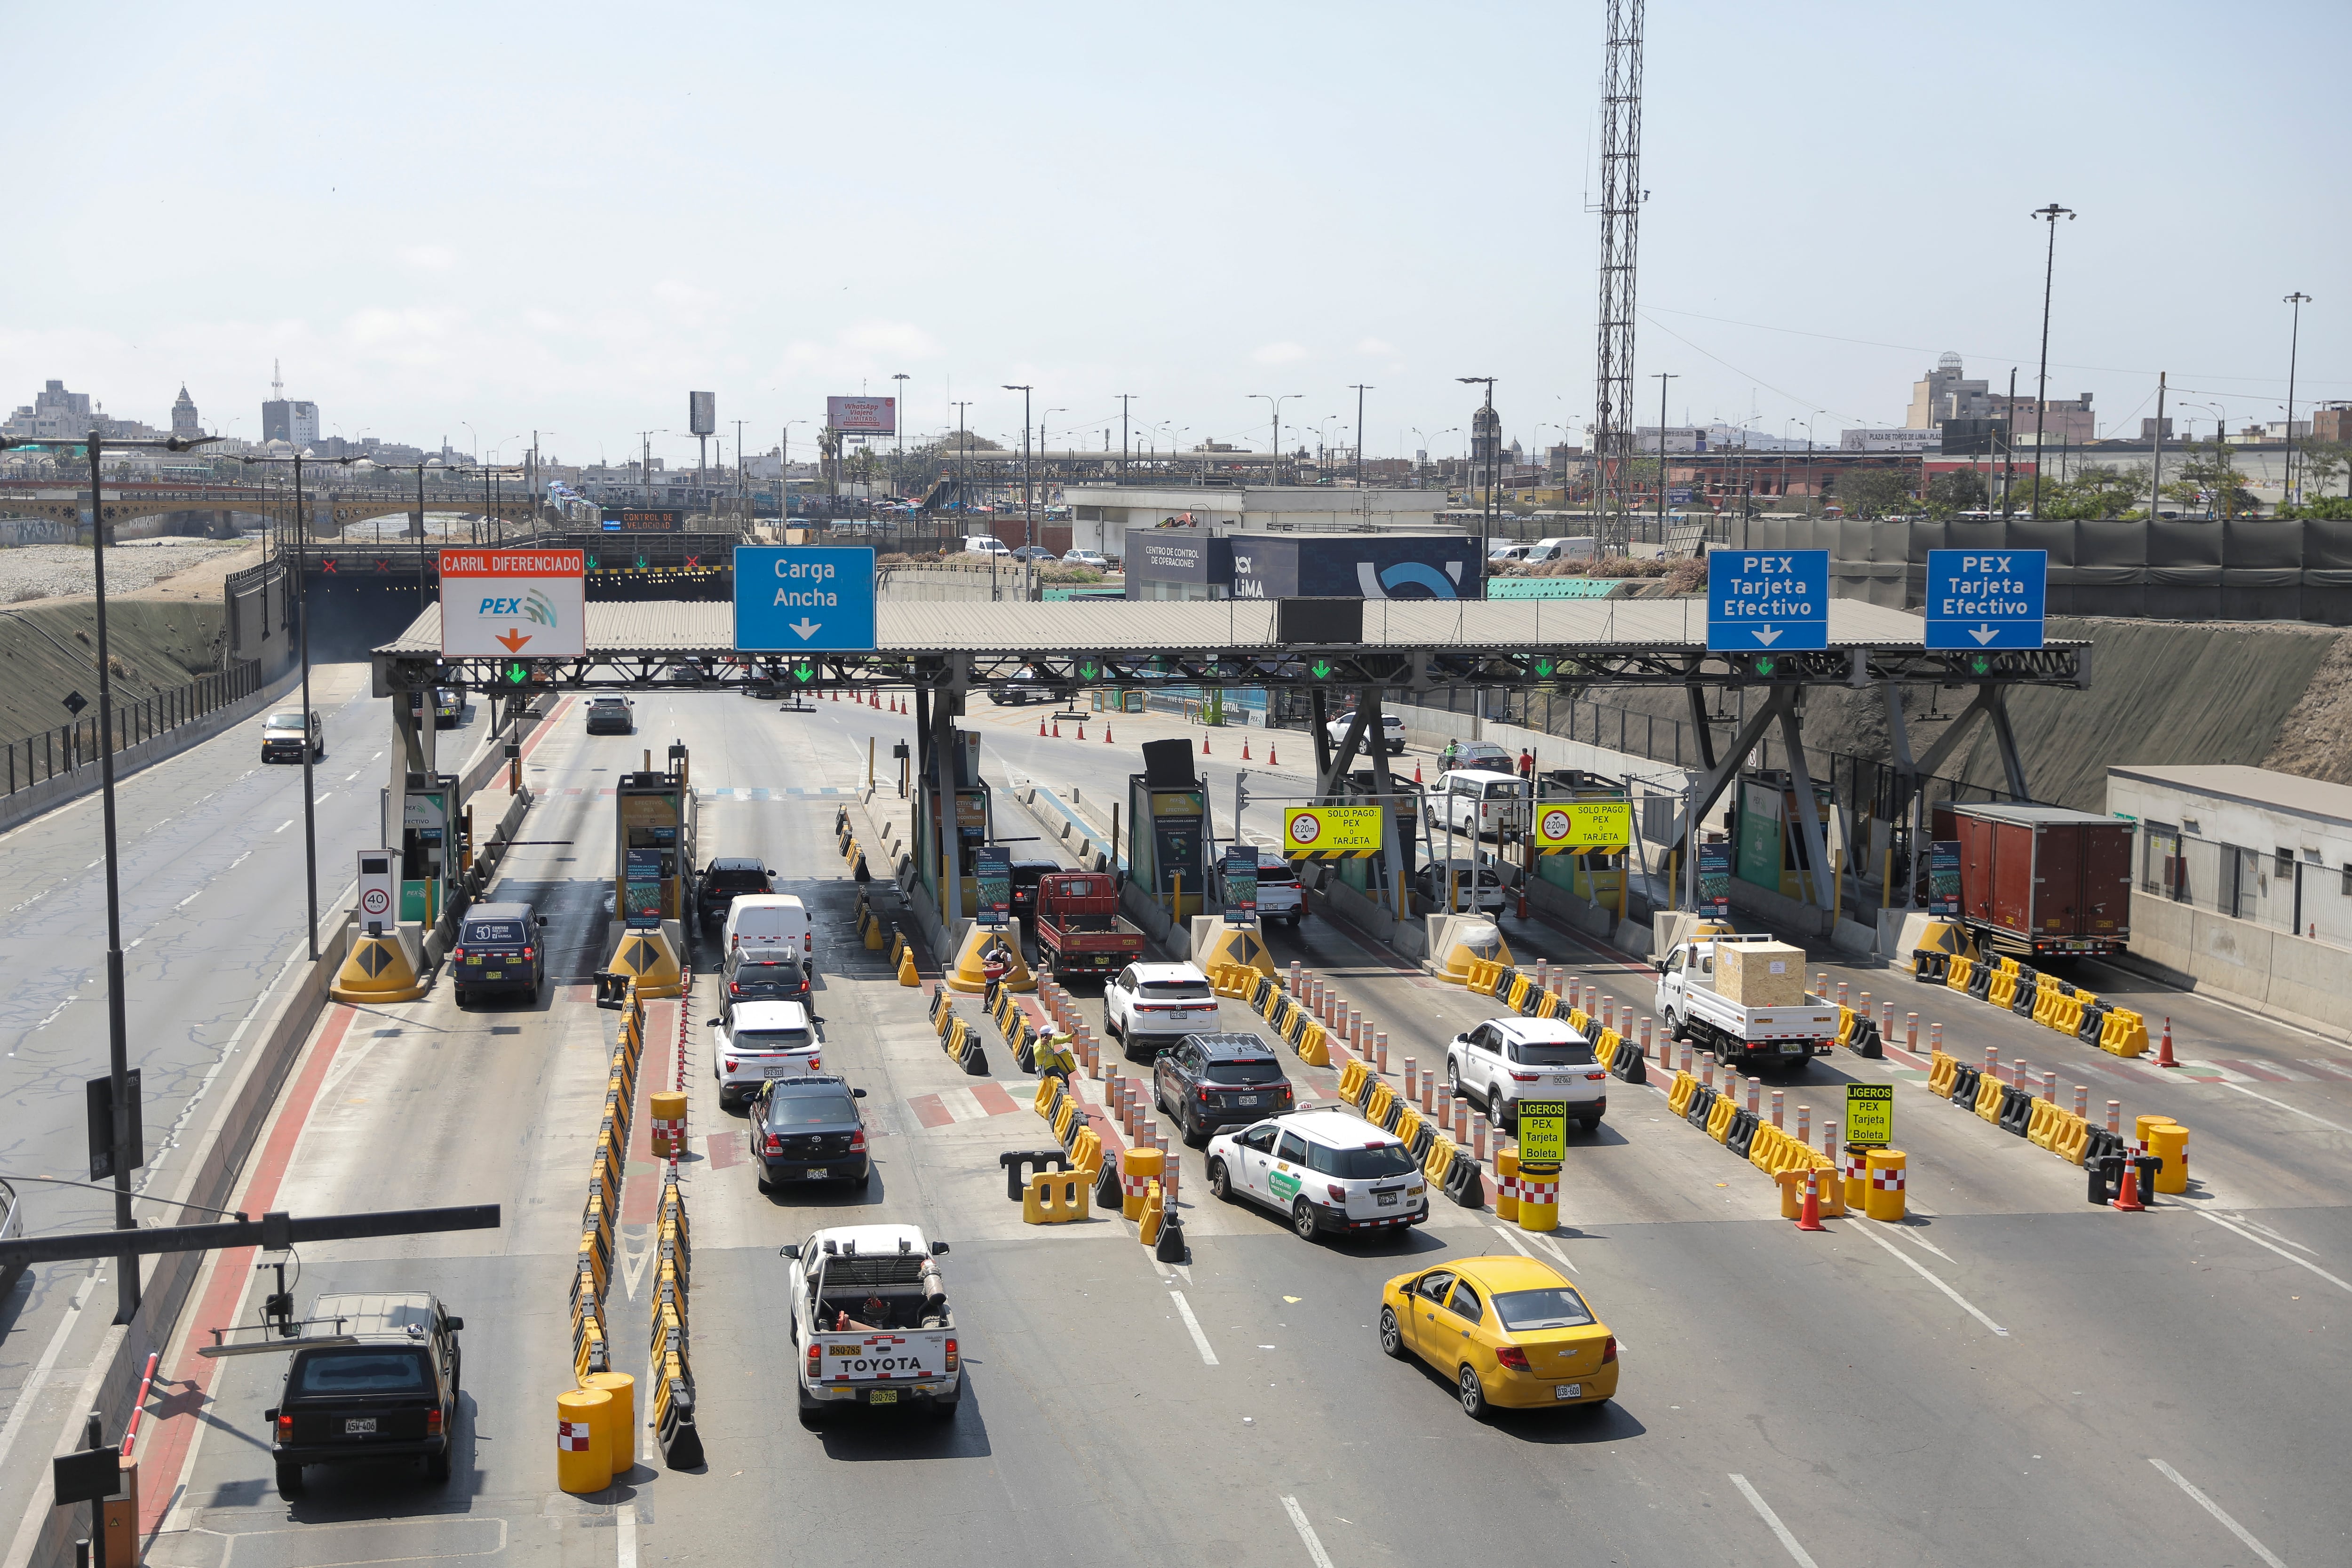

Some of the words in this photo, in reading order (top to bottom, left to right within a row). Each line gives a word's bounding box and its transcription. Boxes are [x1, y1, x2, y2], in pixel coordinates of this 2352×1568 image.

[1146, 546, 1166, 556] CENTRO
[1175, 549, 1199, 558] CONTROL
[443, 557, 488, 571] CARRIL
[492, 557, 580, 571] DIFERENCIADO
[1151, 556, 1158, 565] DE
[1159, 557, 1194, 568] OPERACIONES
[1744, 557, 1793, 573] PEX
[1963, 557, 2011, 573] PEX
[775, 559, 835, 583] Carga
[1731, 577, 1806, 599] Tarjeta
[1949, 577, 2024, 599] Tarjeta
[773, 588, 837, 606] Ancha
[478, 598, 522, 614] PEX
[1724, 598, 1811, 616] Efectivo
[1943, 598, 2027, 614] Efectivo
[367, 894, 383, 903] 40
[476, 926, 491, 939] 50
[1848, 1088, 1891, 1098] LIGEROS
[1520, 1105, 1563, 1114] LIGEROS
[1859, 1102, 1879, 1111] PEX
[1532, 1119, 1552, 1128] PEX
[1853, 1114, 1884, 1125] Tarjeta
[1526, 1132, 1557, 1144] Tarjeta
[1853, 1130, 1883, 1139] Boleta
[1526, 1148, 1557, 1157] Boleta
[1276, 1177, 1291, 1189] inDriver
[830, 1346, 860, 1355] B8Q-785
[841, 1357, 921, 1372] TOYOTA
[1557, 1385, 1580, 1397] D3B-608
